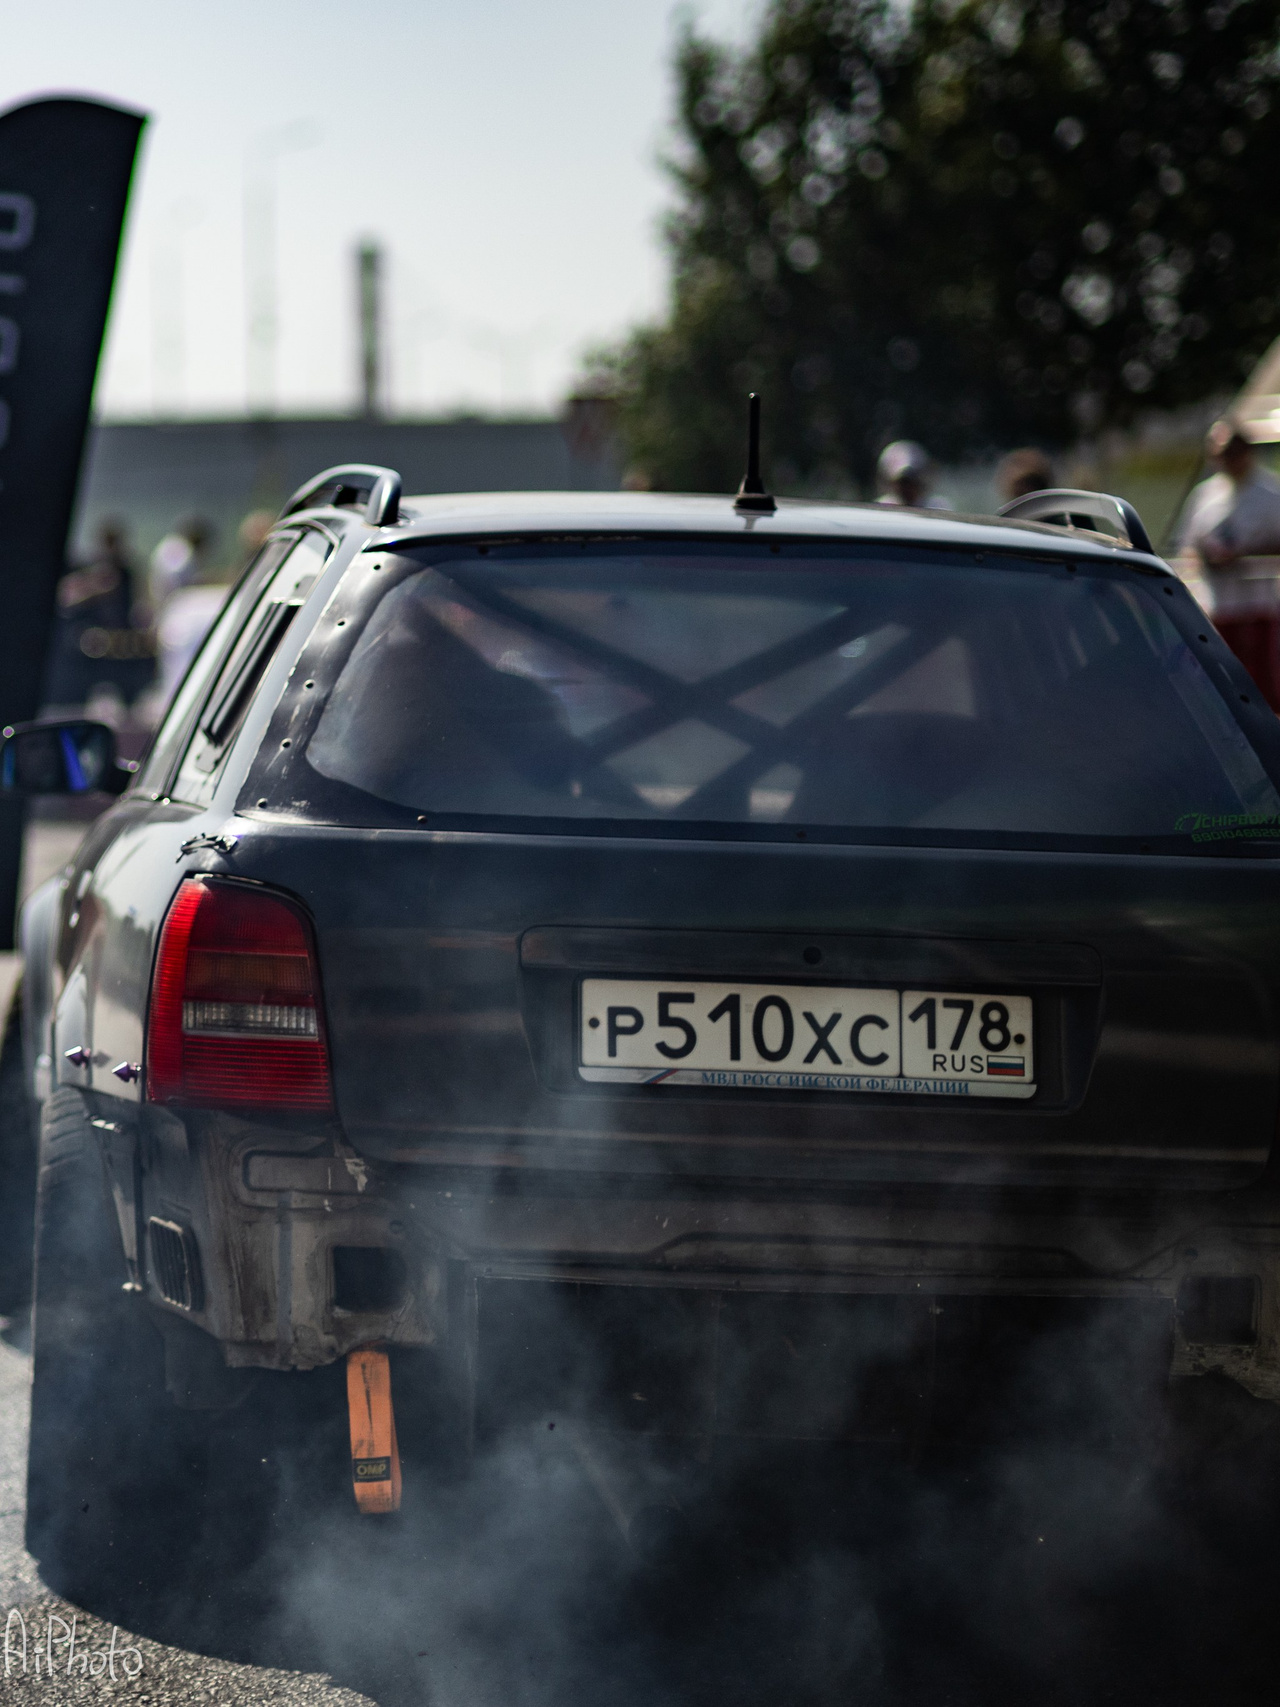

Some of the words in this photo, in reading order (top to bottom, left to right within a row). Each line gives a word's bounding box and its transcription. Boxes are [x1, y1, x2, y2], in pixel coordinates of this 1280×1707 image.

[908, 998, 1011, 1053] 178
[933, 1054, 985, 1075] RUS
[701, 1071, 738, 1087] МВД
[866, 1077, 970, 1095] ФЕДЕРАЦИИ
[356, 1463, 387, 1477] OMP
